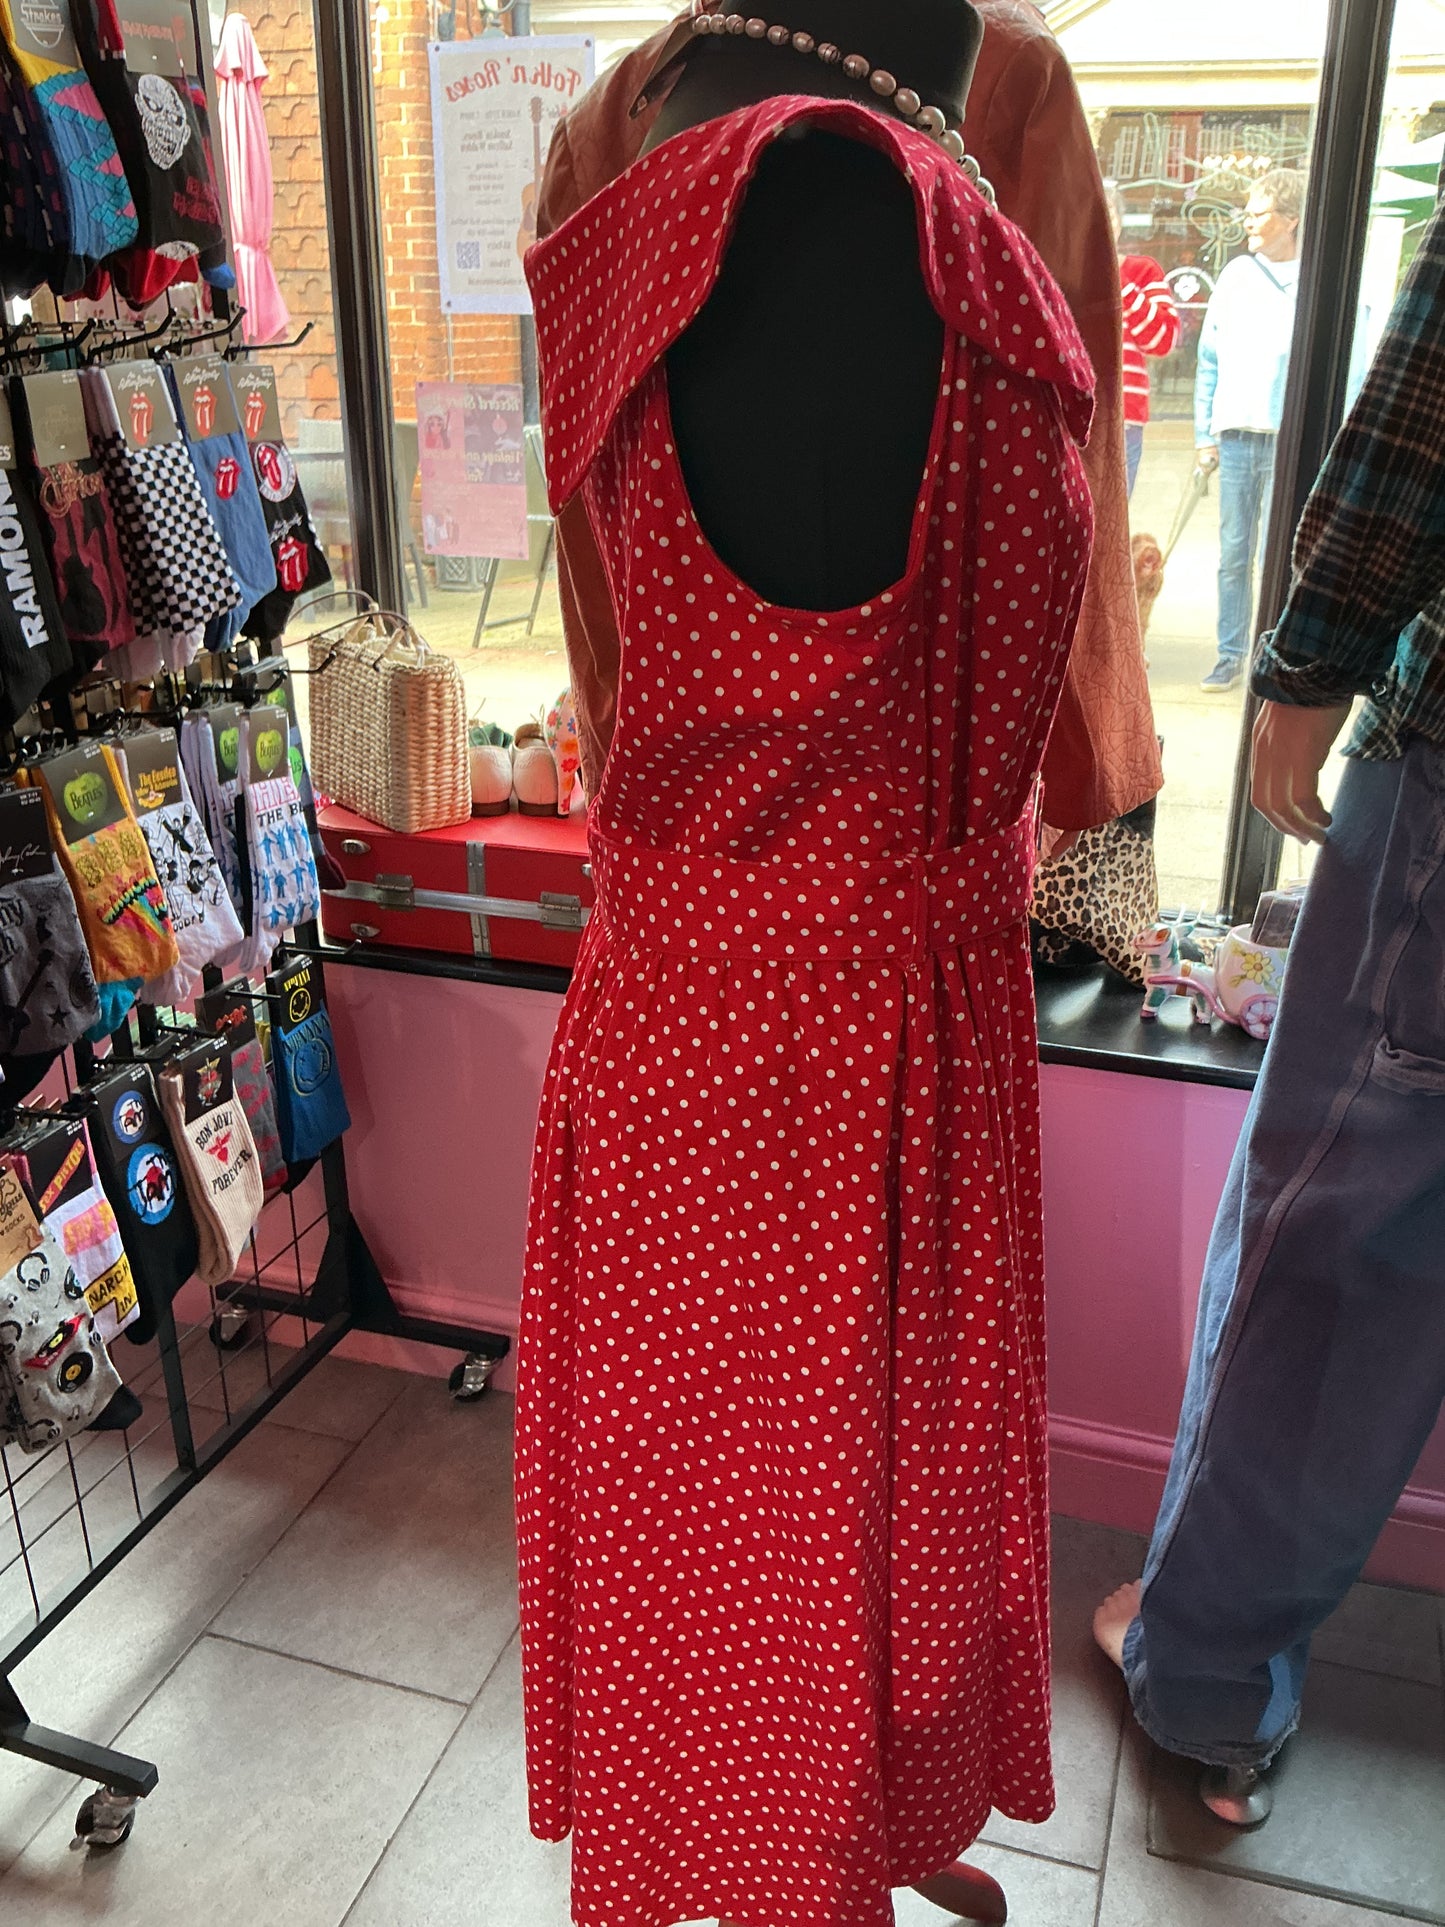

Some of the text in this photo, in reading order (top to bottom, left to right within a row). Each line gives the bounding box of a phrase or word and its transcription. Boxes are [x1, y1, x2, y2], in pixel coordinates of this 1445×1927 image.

[0, 468, 49, 649] RAMON
[257, 807, 283, 827] THE
[281, 1013, 329, 1054] NIRVANA
[195, 1110, 234, 1150] BON JOVI
[211, 1149, 253, 1195] FOREVER
[4, 1213, 25, 1233] SOCKS
[88, 1264, 130, 1305] NARCH
